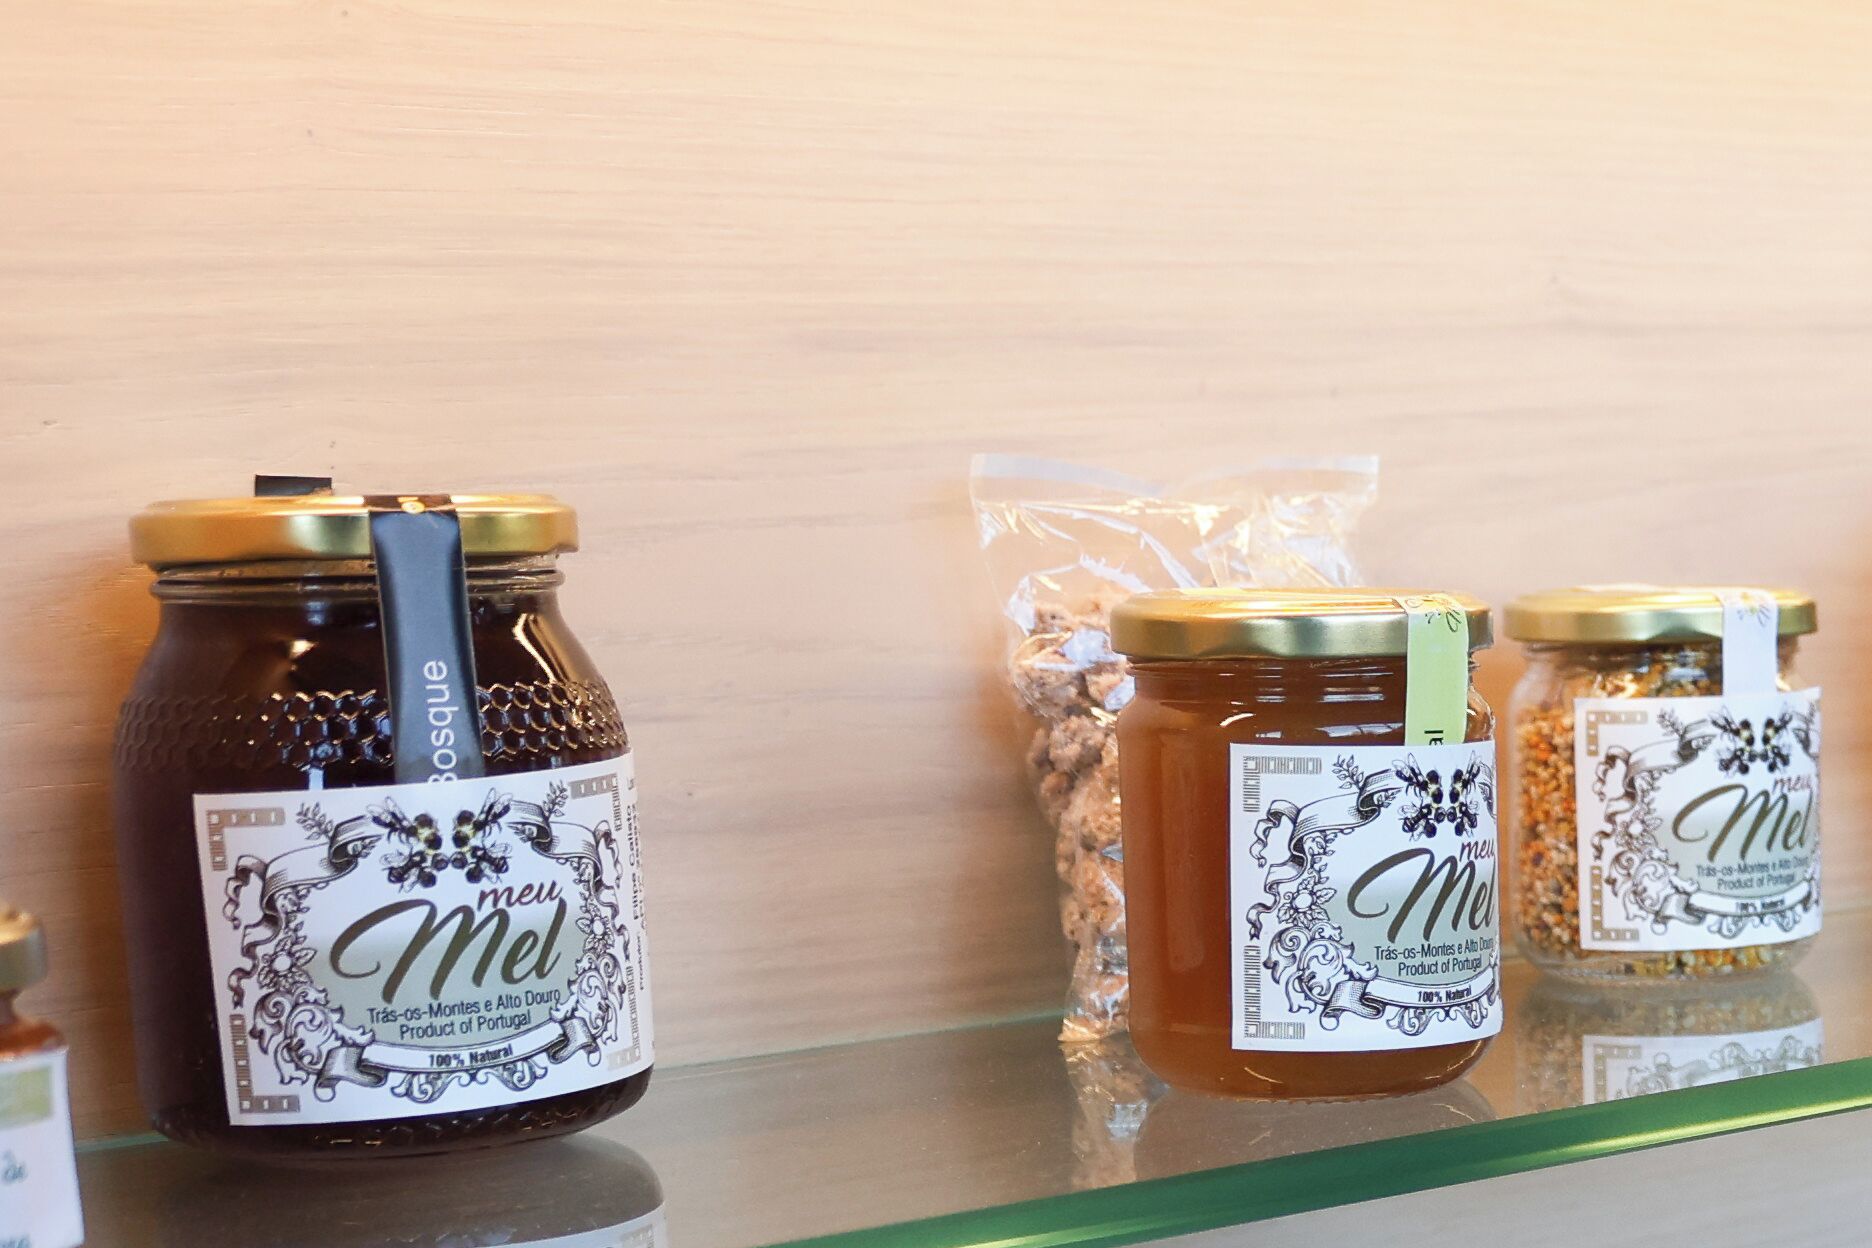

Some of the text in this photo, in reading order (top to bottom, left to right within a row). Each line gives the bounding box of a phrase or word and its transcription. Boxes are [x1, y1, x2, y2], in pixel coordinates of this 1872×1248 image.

[1671, 783, 1814, 863] Mel
[1459, 838, 1495, 862] meu
[477, 879, 563, 912] meu
[1347, 847, 1496, 944] Mel
[329, 897, 568, 1005] Mel
[1374, 942, 1456, 961] Trás-os-Montes
[1457, 944, 1463, 953] e
[1398, 955, 1483, 977] Product of Portugal
[367, 989, 562, 1025] Trás-os-Montes e Alto Douro
[1417, 986, 1472, 1003] 100% Natural
[400, 1012, 532, 1041] Product of Portugal
[429, 1044, 513, 1068] 100% Natural
